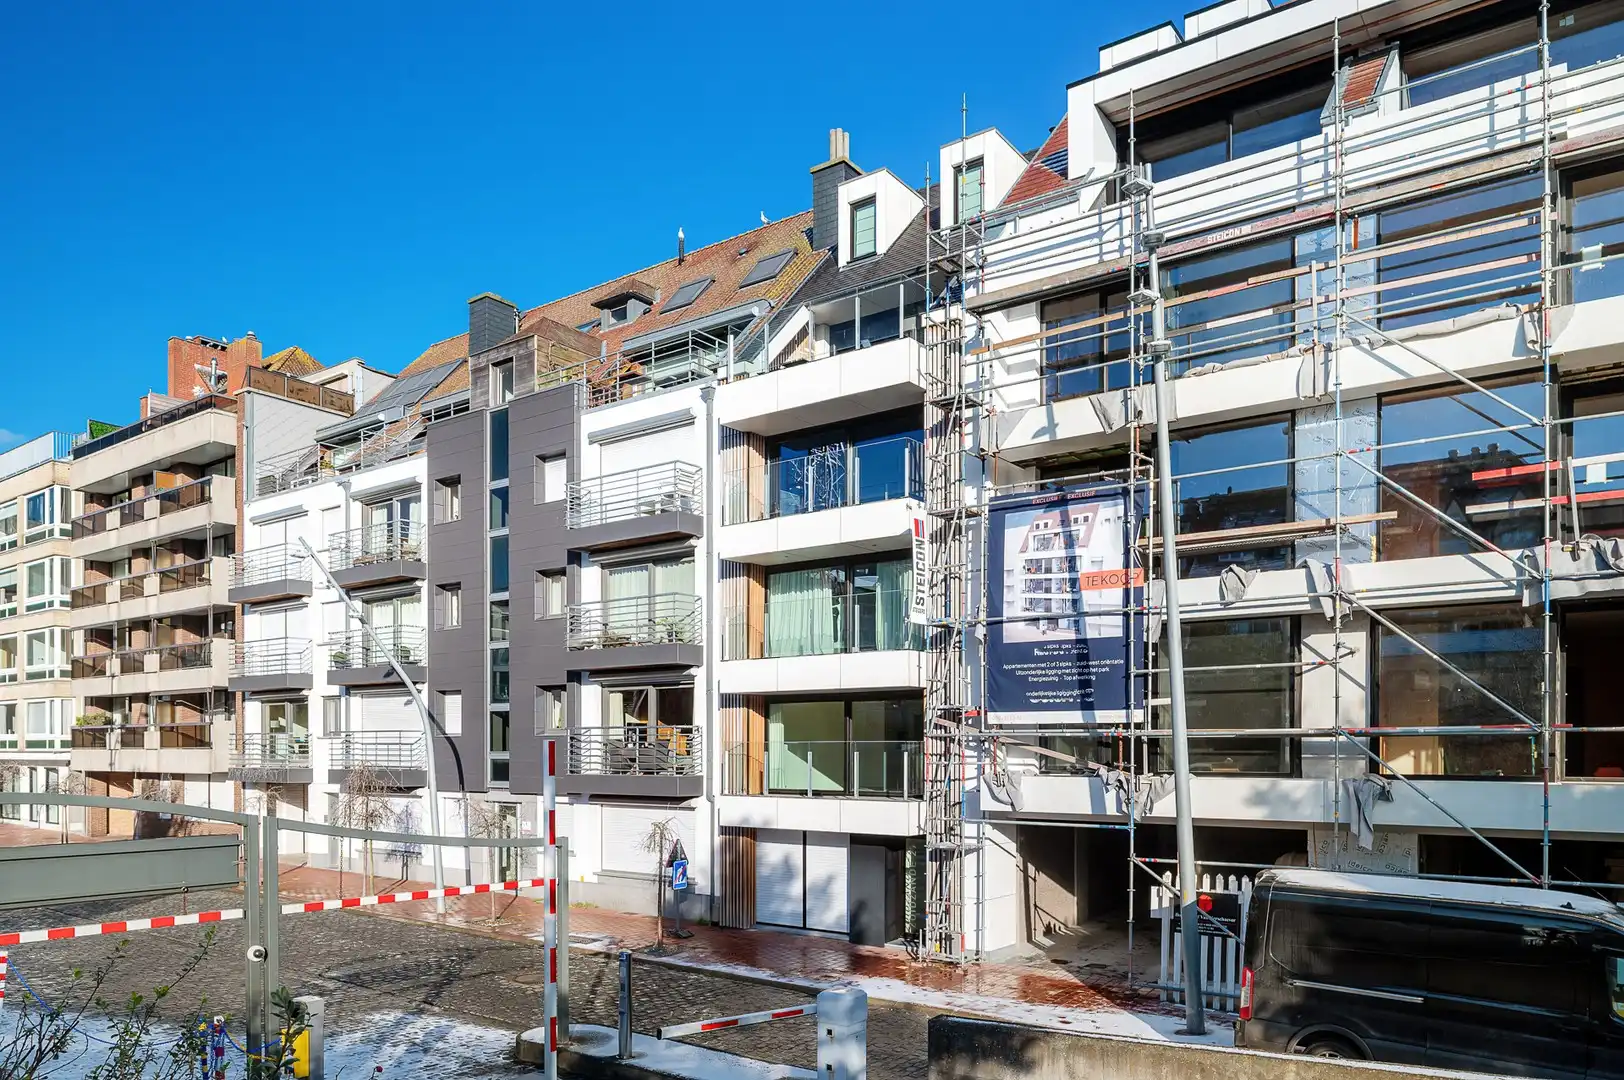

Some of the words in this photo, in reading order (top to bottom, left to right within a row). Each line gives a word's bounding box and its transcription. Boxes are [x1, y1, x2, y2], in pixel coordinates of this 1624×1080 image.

[1067, 490, 1096, 499] EXCLUSIF
[915, 538, 926, 607] STEICON
[1085, 575, 1098, 587] TE
